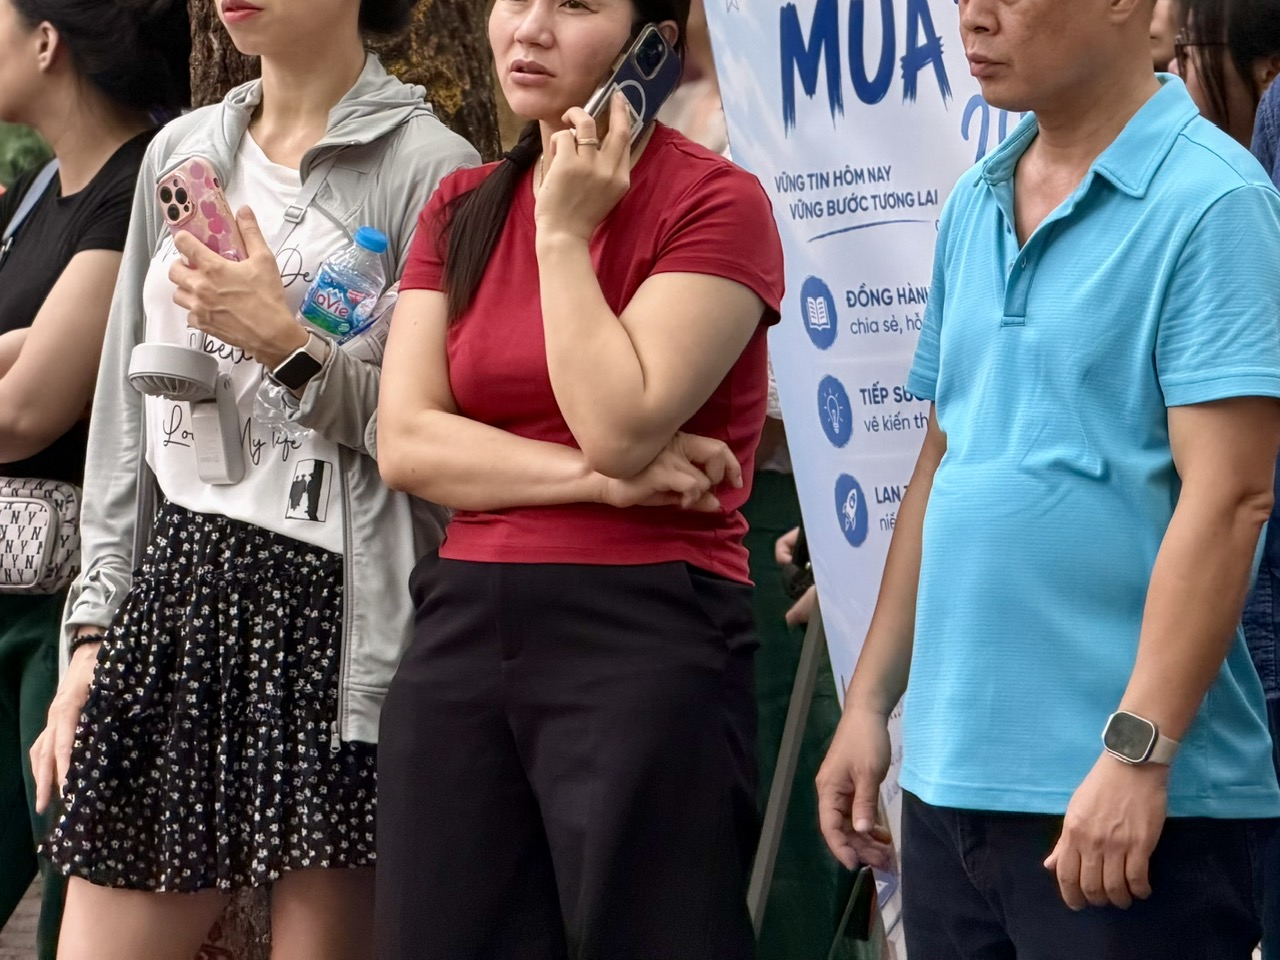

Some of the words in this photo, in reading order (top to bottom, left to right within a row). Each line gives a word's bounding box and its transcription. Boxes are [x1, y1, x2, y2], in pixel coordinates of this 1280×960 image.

[775, 171, 806, 193] VỮNG
[807, 171, 830, 191] TIN
[833, 164, 866, 187] HÔM
[868, 165, 892, 183] NAY
[789, 199, 824, 220] VỮNG
[826, 192, 869, 217] BƯỚC
[871, 191, 915, 211] TƯƠNG
[917, 189, 939, 207] LAI
[846, 282, 893, 308] ĐỒNG
[850, 317, 880, 335] chia
[859, 381, 889, 405] TIẾP
[882, 411, 911, 431] kiến
[875, 485, 901, 504] LAN
